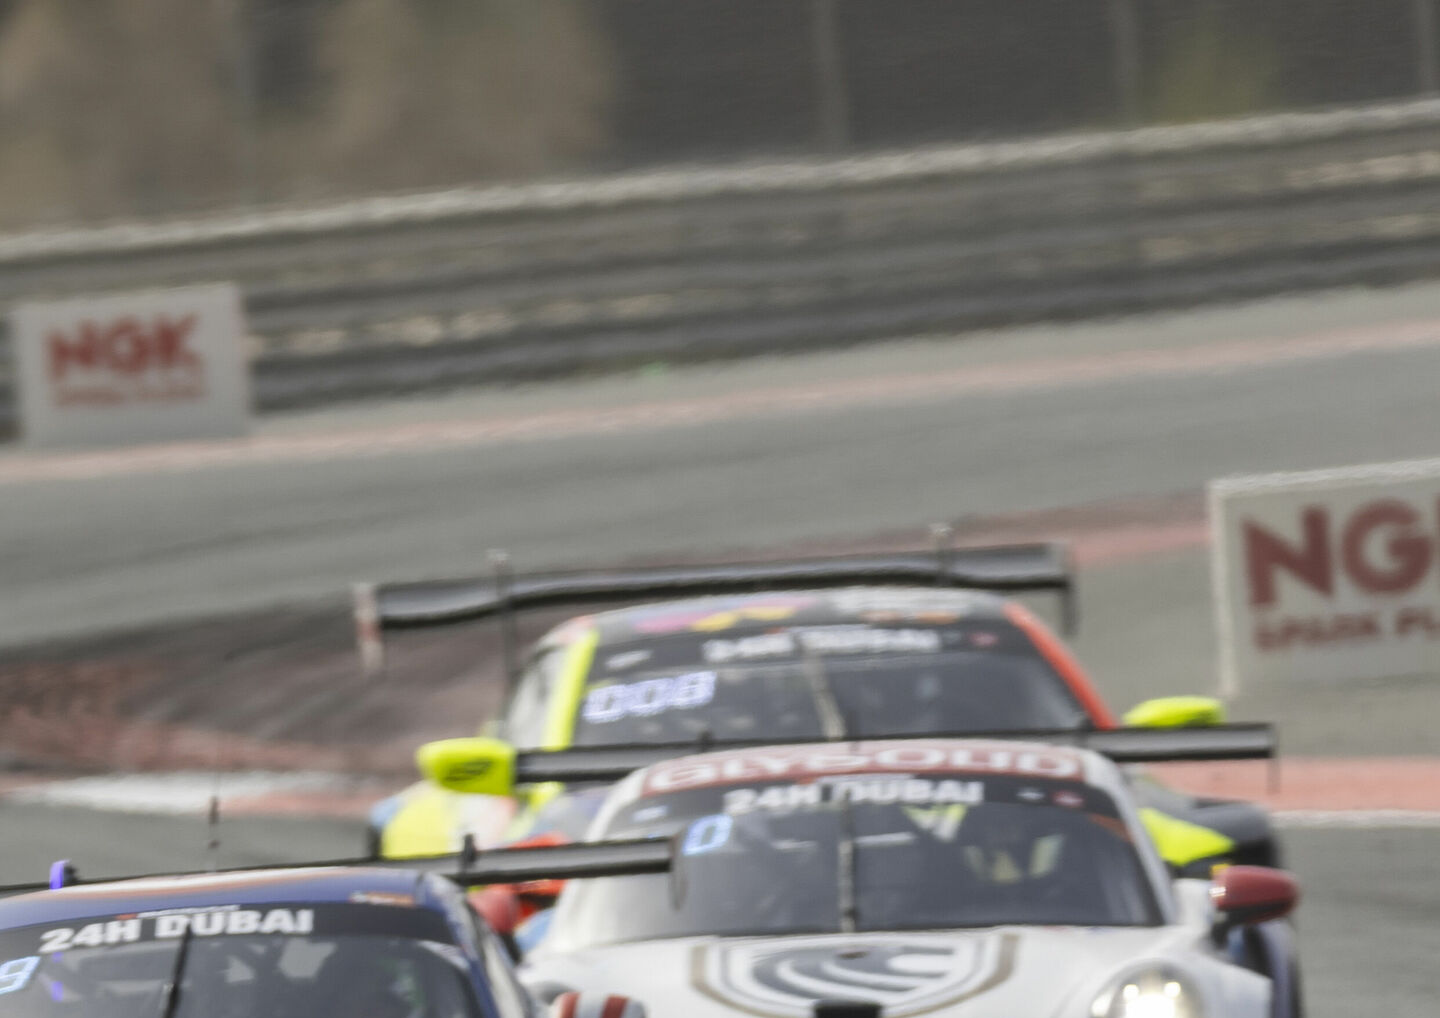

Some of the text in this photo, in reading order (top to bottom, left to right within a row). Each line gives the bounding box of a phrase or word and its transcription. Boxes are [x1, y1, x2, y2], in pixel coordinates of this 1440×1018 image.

[1242, 498, 1440, 606] NG
[40, 918, 141, 953] 24H
[154, 908, 315, 938] DUBAI
